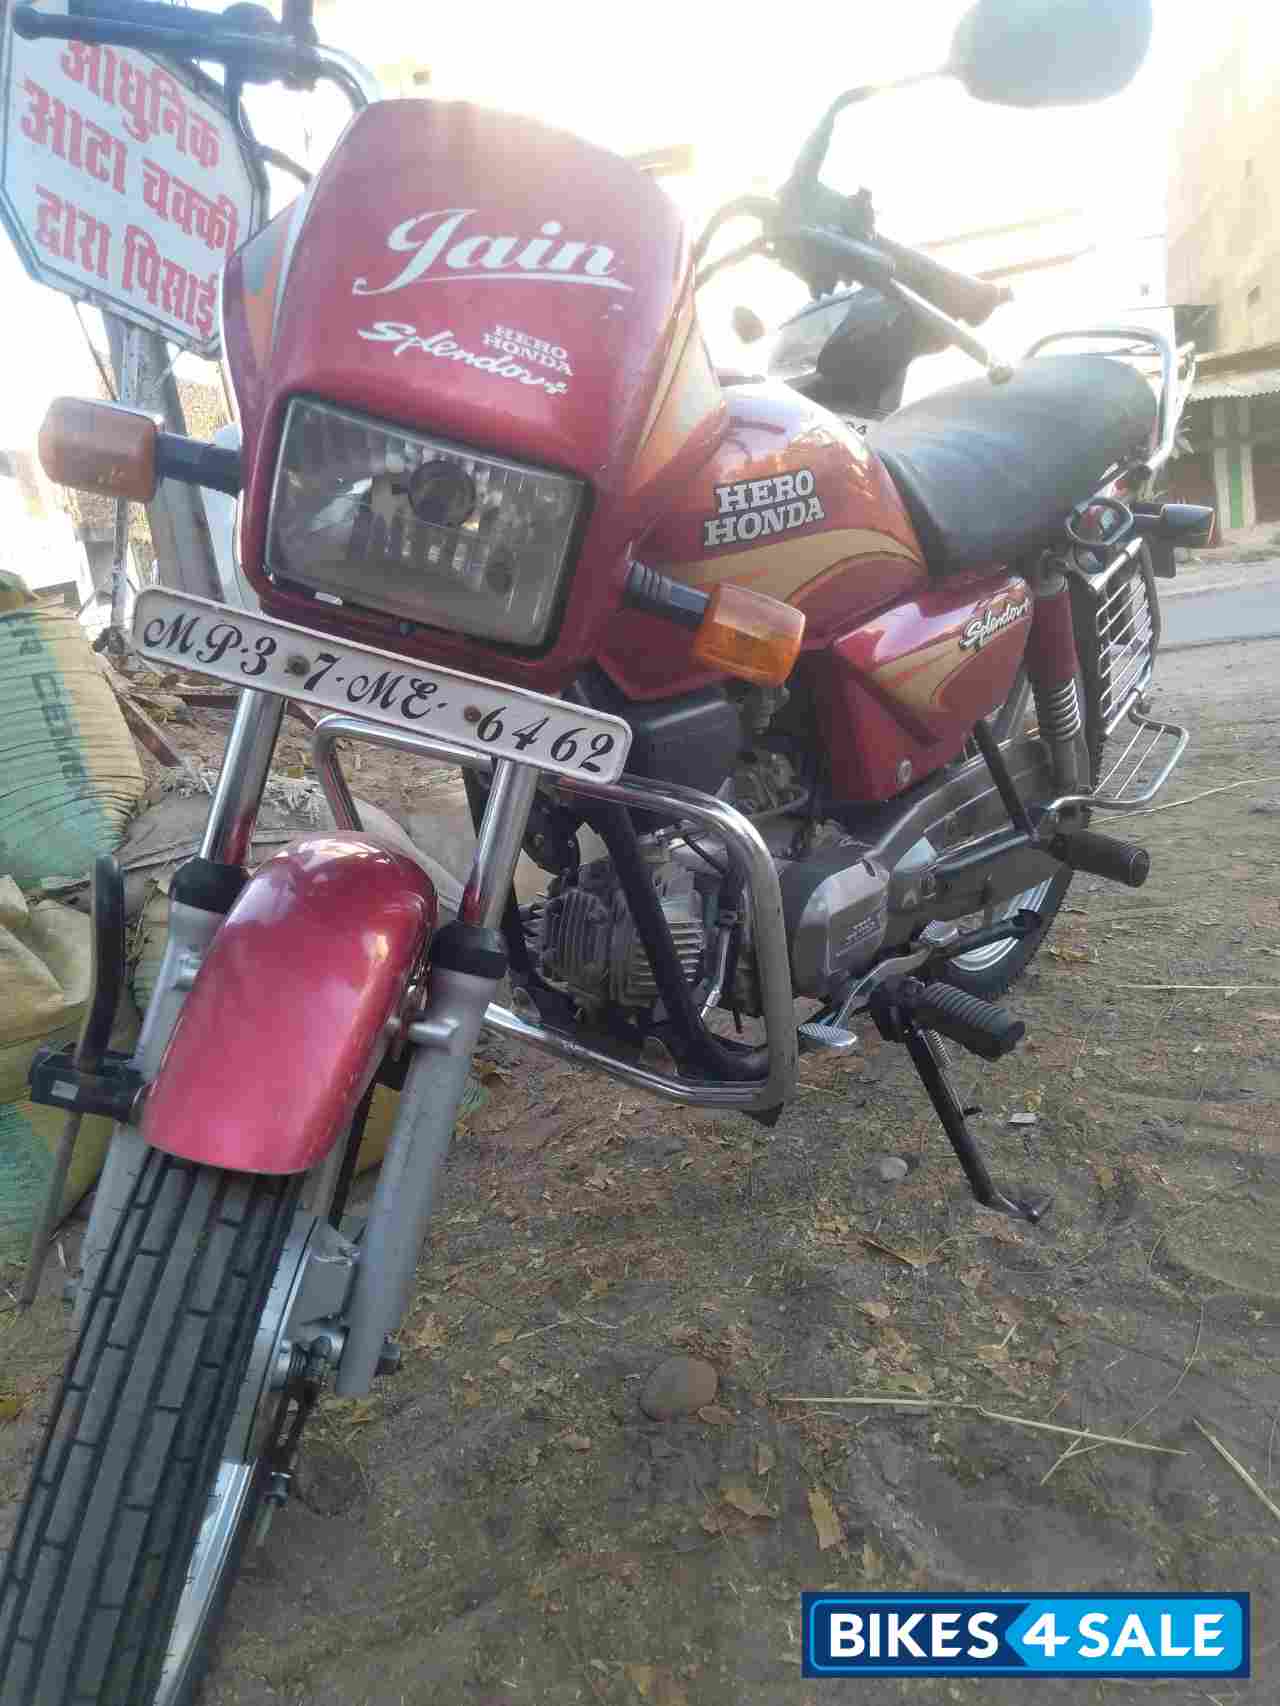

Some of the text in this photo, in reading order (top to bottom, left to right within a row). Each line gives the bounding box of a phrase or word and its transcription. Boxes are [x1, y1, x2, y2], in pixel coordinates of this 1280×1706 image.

[20, 74, 240, 256] आटा चक्की
[352, 208, 620, 295] Jain
[482, 333, 574, 377] HONDA
[495, 324, 568, 360] HERO
[714, 469, 815, 513] HERO
[703, 497, 825, 547] HONDA
